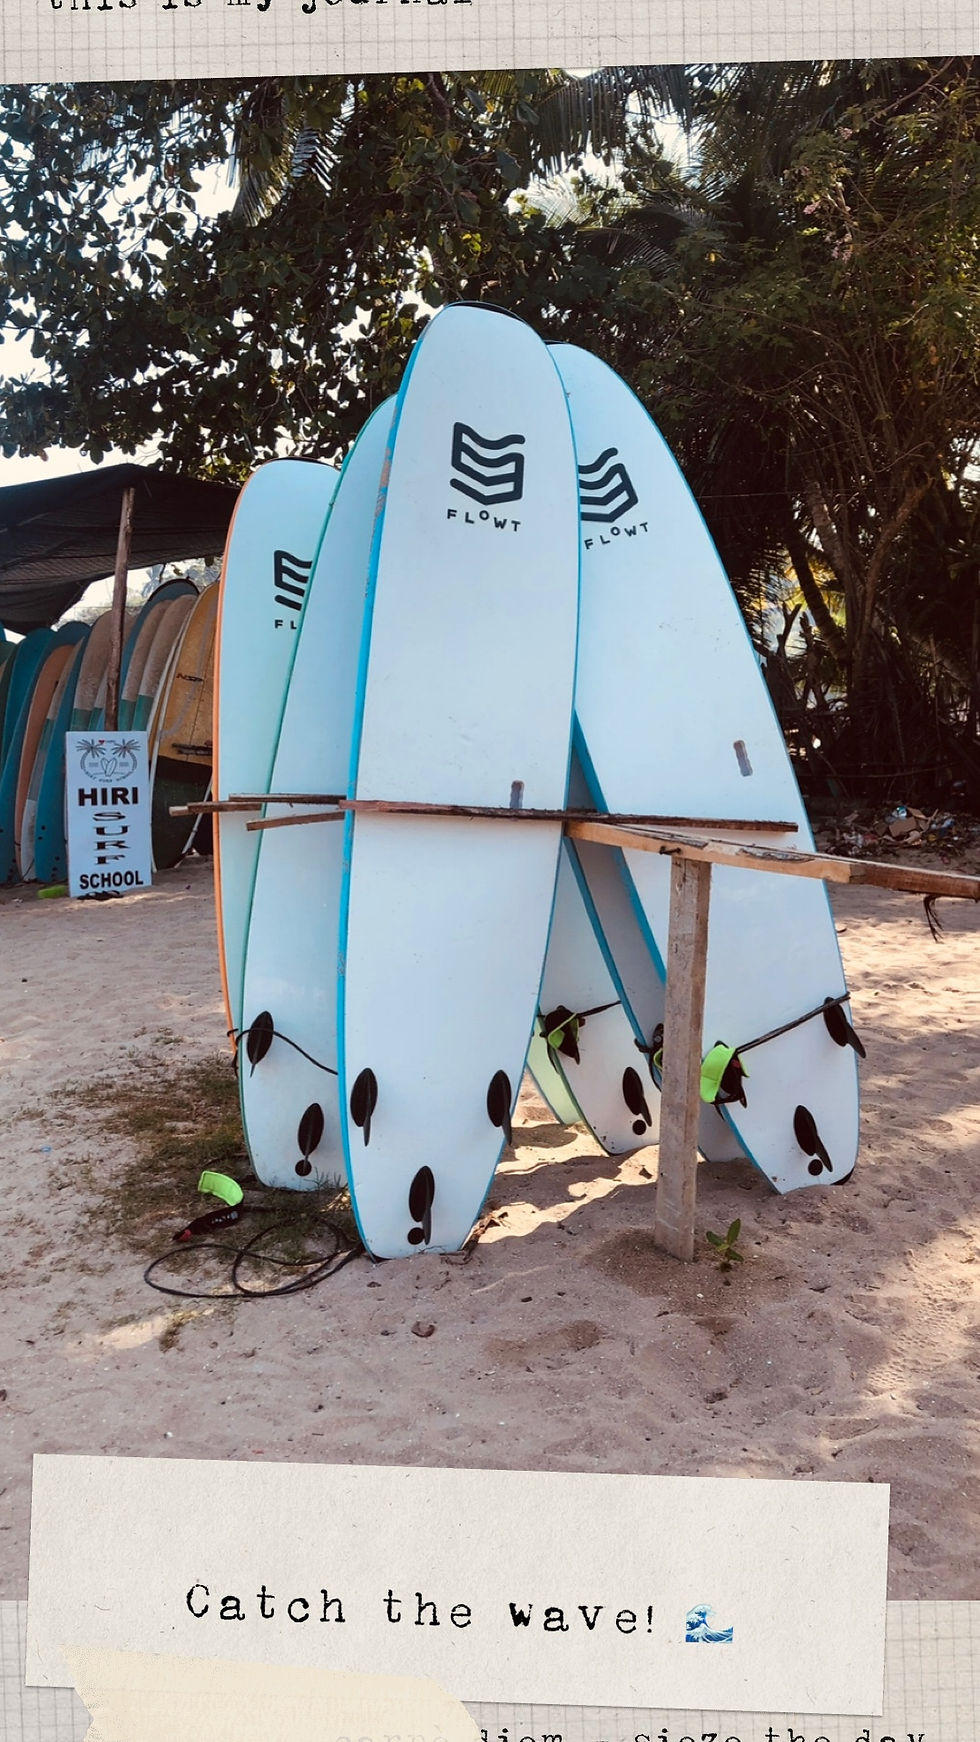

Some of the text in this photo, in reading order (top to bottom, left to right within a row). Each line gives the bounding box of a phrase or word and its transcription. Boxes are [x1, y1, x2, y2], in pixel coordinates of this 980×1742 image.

[446, 508, 521, 532] FLOWT
[584, 522, 648, 550] FLOWT
[78, 786, 139, 807] HIRI
[92, 811, 131, 865] SURF
[79, 870, 144, 890] SCHOOL
